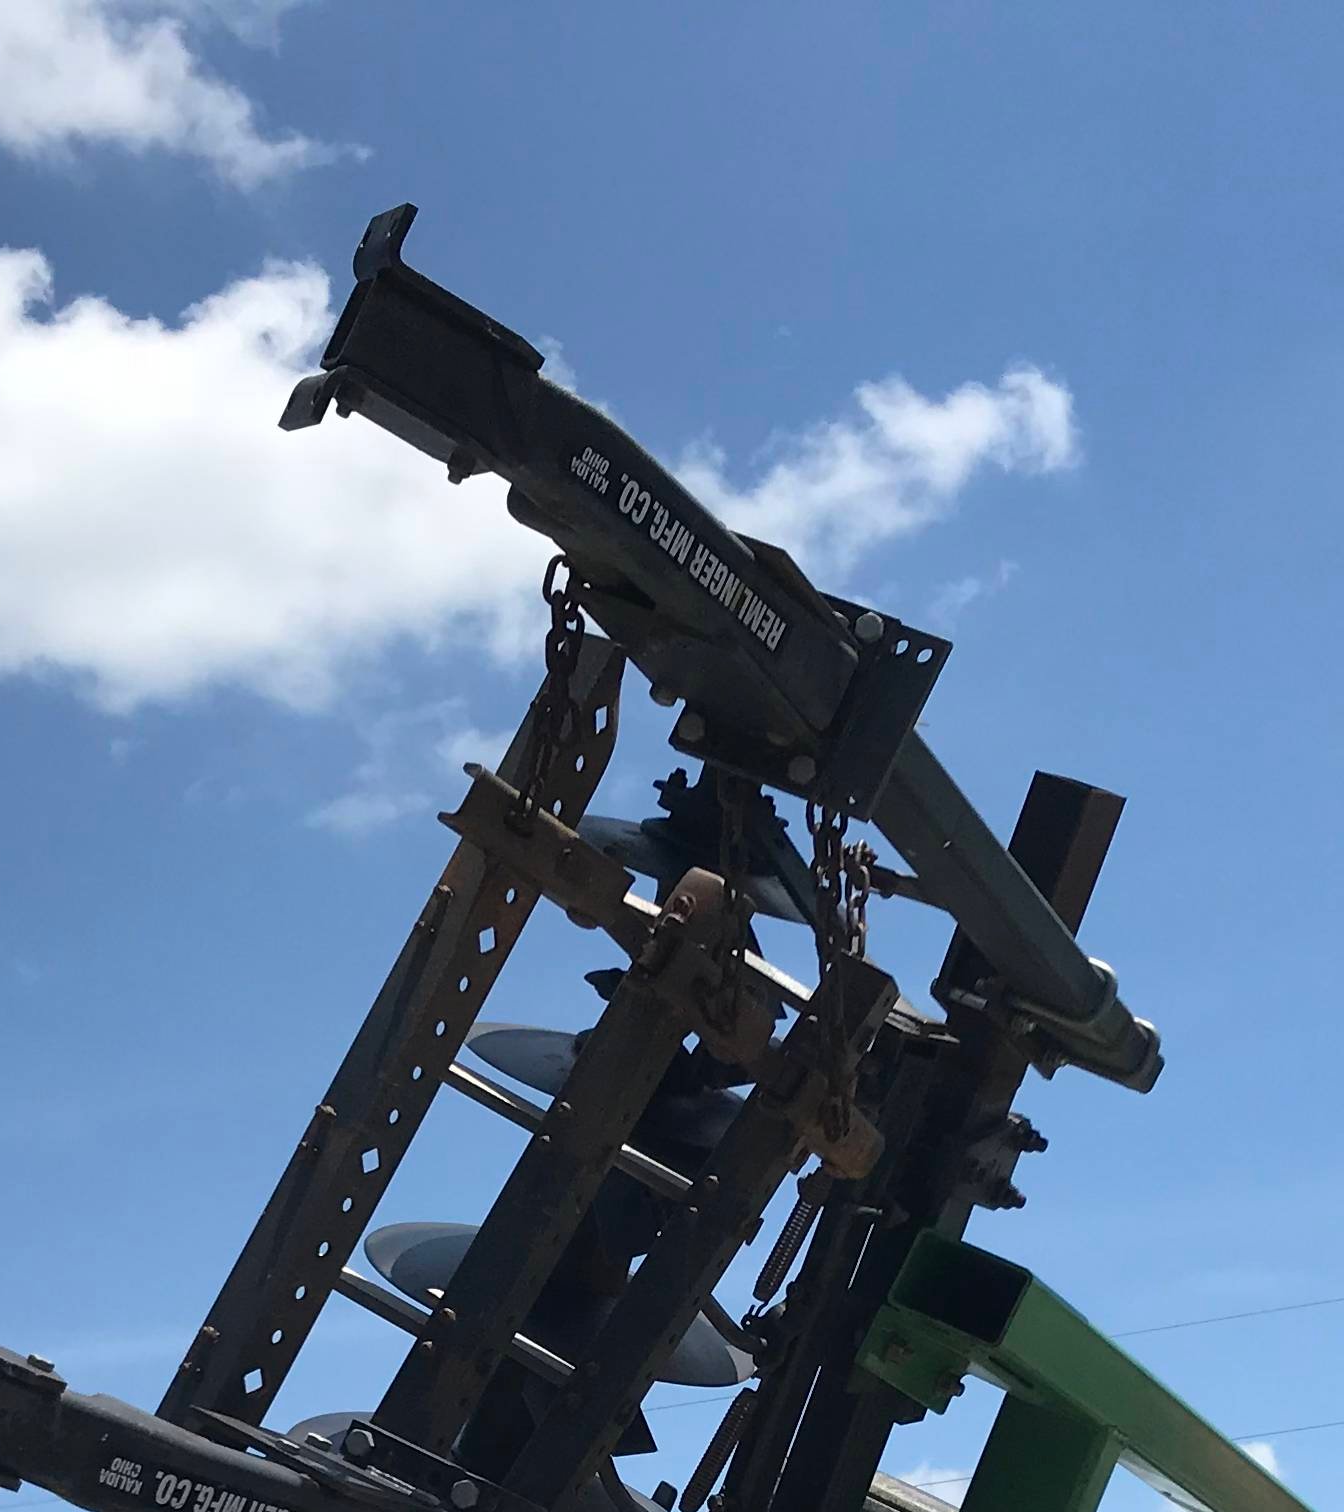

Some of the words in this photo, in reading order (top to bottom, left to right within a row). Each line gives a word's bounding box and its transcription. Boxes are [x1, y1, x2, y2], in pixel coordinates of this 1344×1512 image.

[582, 446, 611, 474] OHIO
[689, 543, 788, 652] REMLINGER
[98, 1468, 144, 1496] KALIDA
